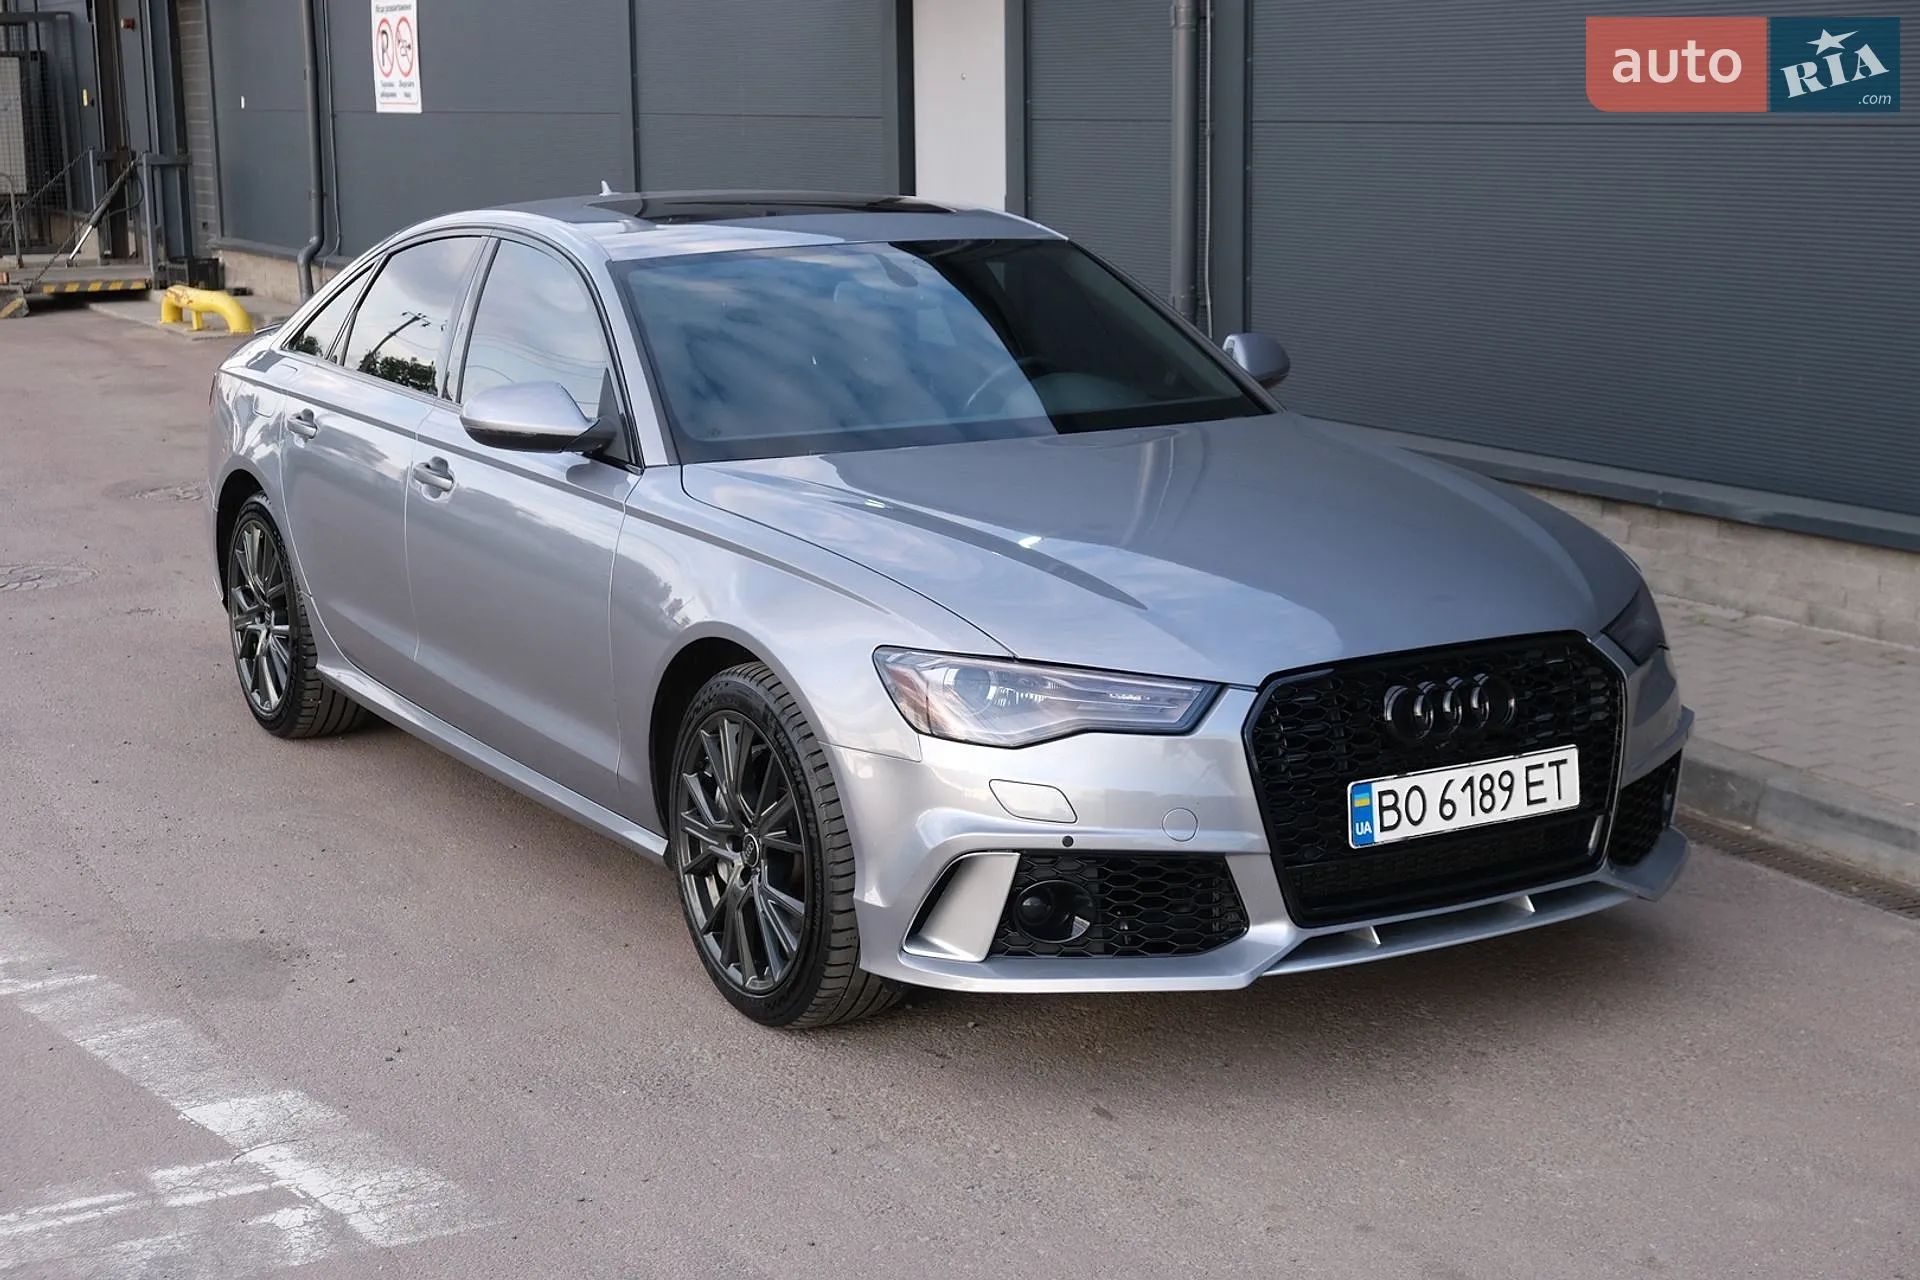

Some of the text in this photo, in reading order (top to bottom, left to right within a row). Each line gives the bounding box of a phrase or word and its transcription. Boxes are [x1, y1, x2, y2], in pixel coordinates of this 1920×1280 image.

[1377, 758, 1569, 833] BO 6189 ET
[1354, 822, 1373, 836] UA
